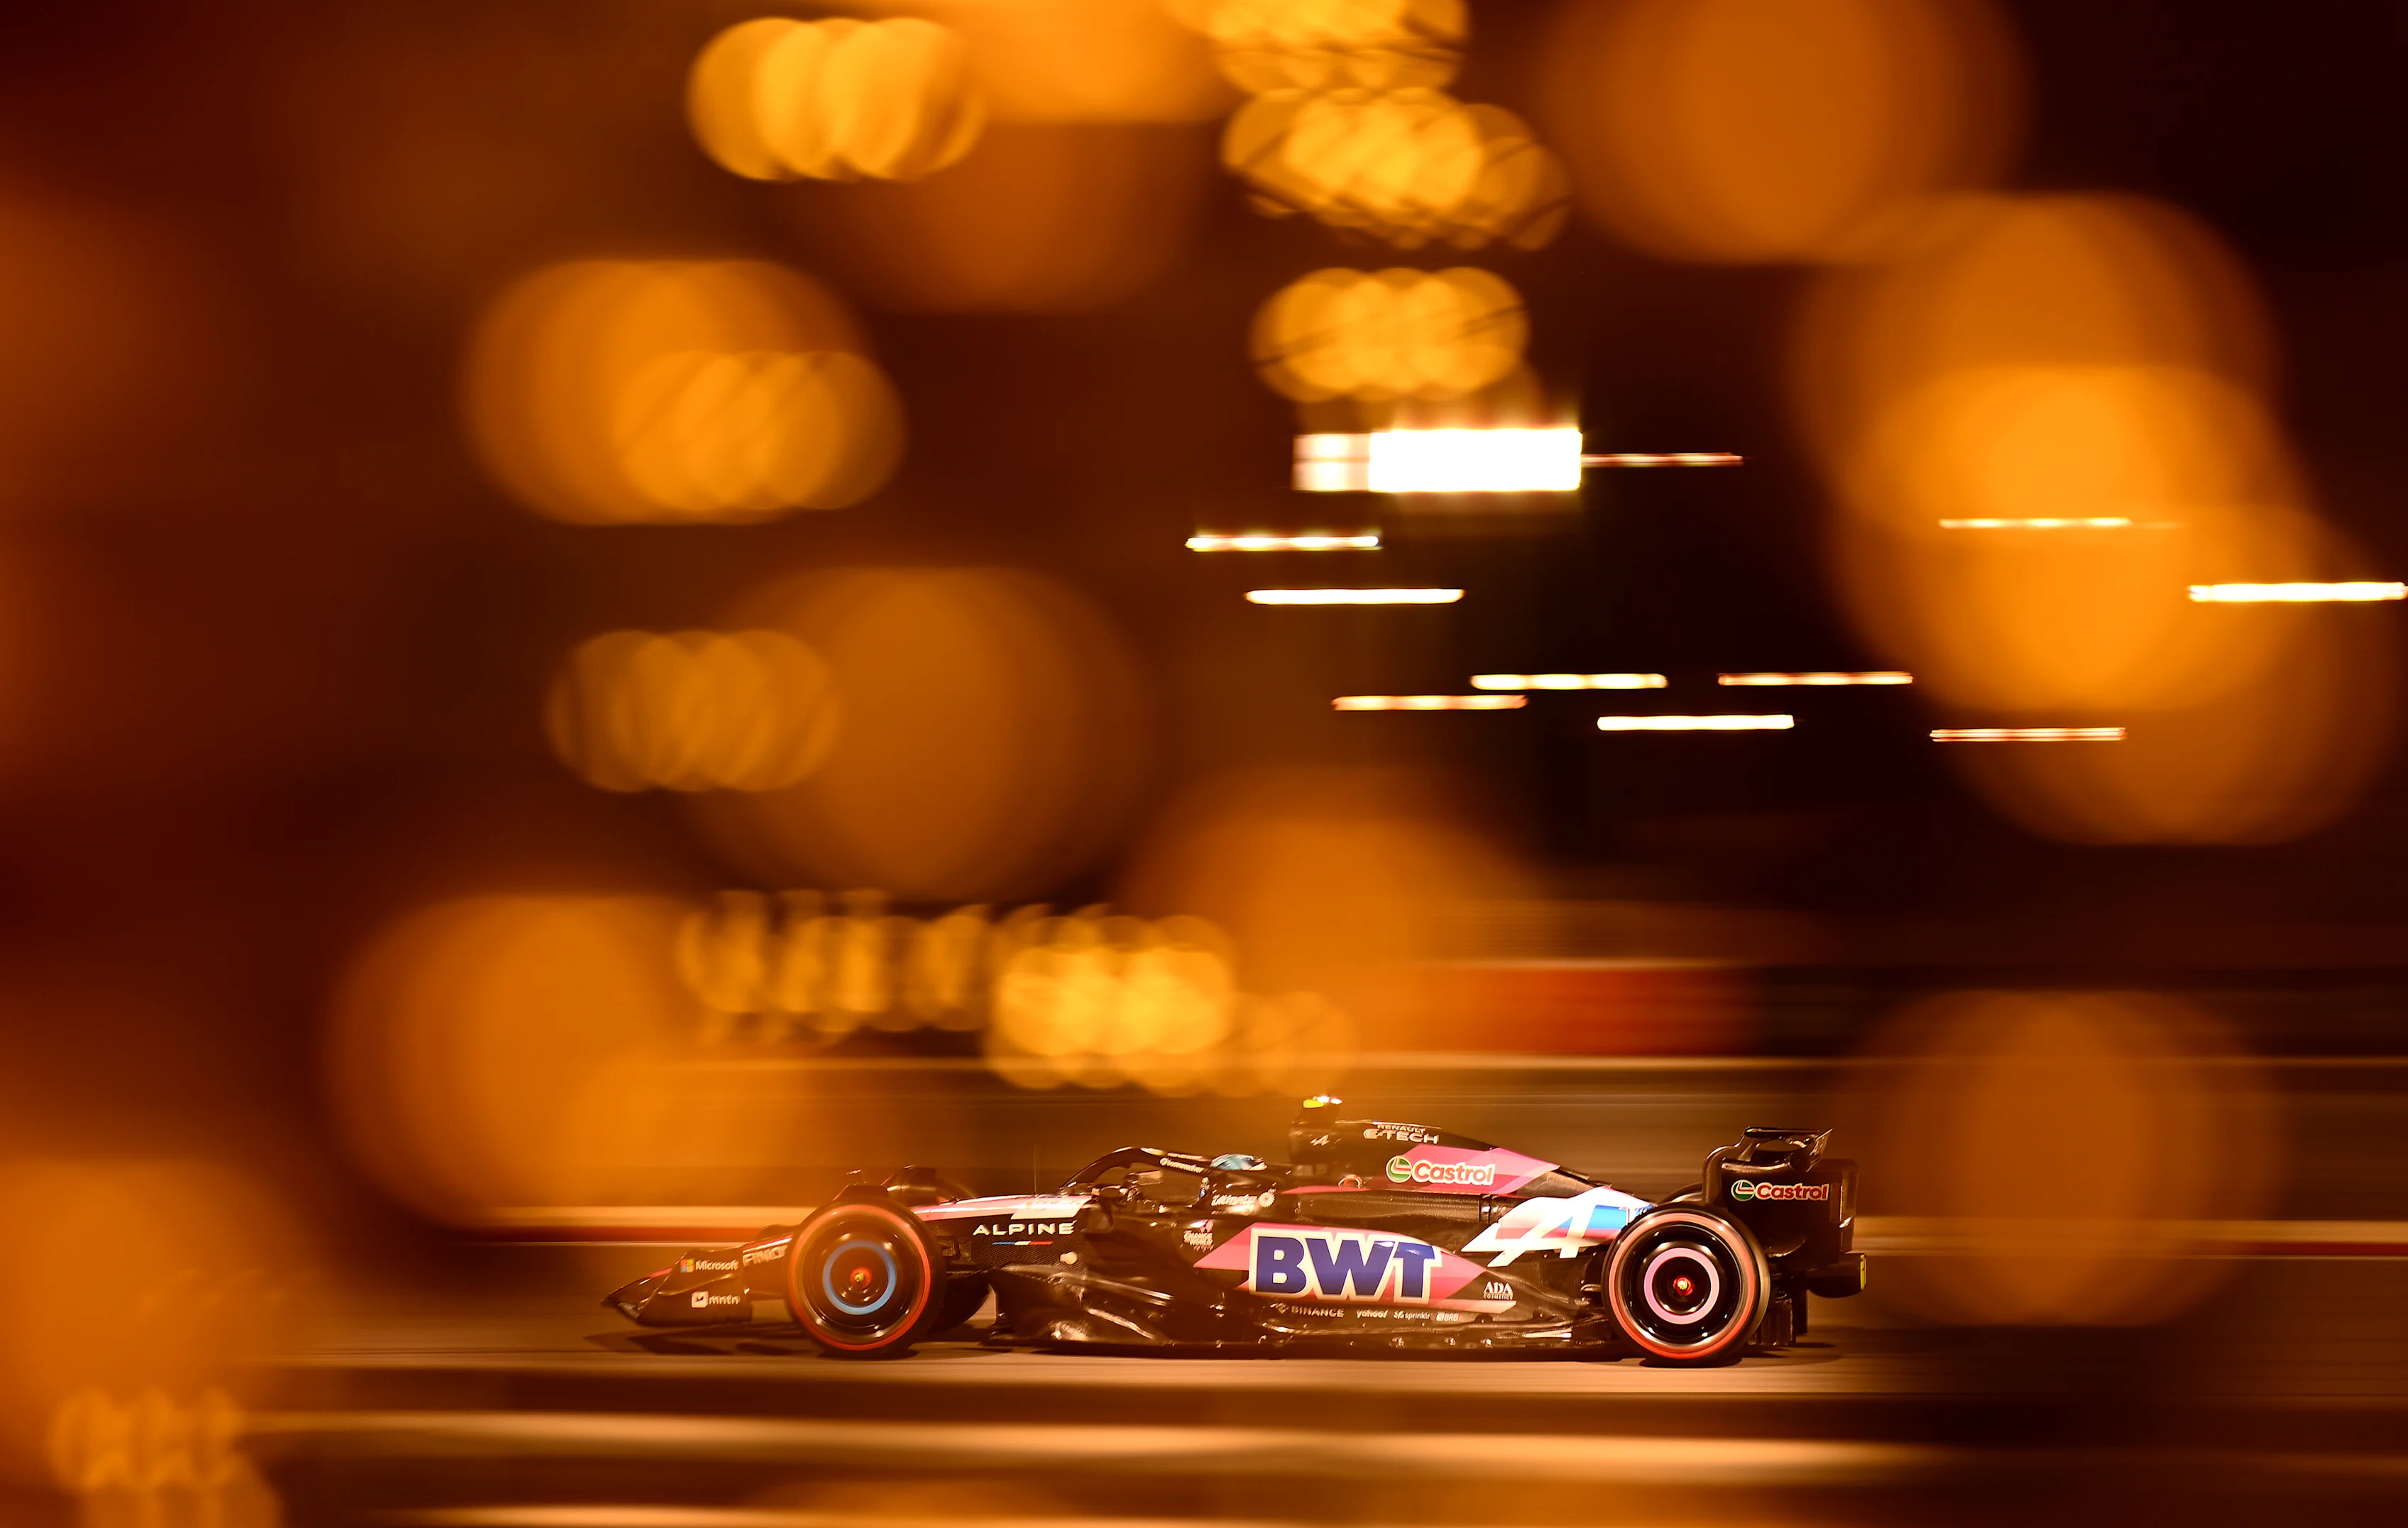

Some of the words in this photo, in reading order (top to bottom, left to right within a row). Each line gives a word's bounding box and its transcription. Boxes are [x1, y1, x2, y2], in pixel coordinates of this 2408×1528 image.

[1378, 1124, 1426, 1133] RENAULT
[1412, 1160, 1496, 1185] Castrol
[1756, 1182, 1829, 1201] Castrol
[973, 1220, 1077, 1235] ALPINE
[695, 1259, 739, 1270] Microsoft
[1256, 1236, 1435, 1297] BWT
[1484, 1281, 1513, 1294] ADA
[709, 1295, 740, 1304] mntn
[1291, 1306, 1345, 1317] BINANCE
[1404, 1312, 1430, 1320] sprinklr
